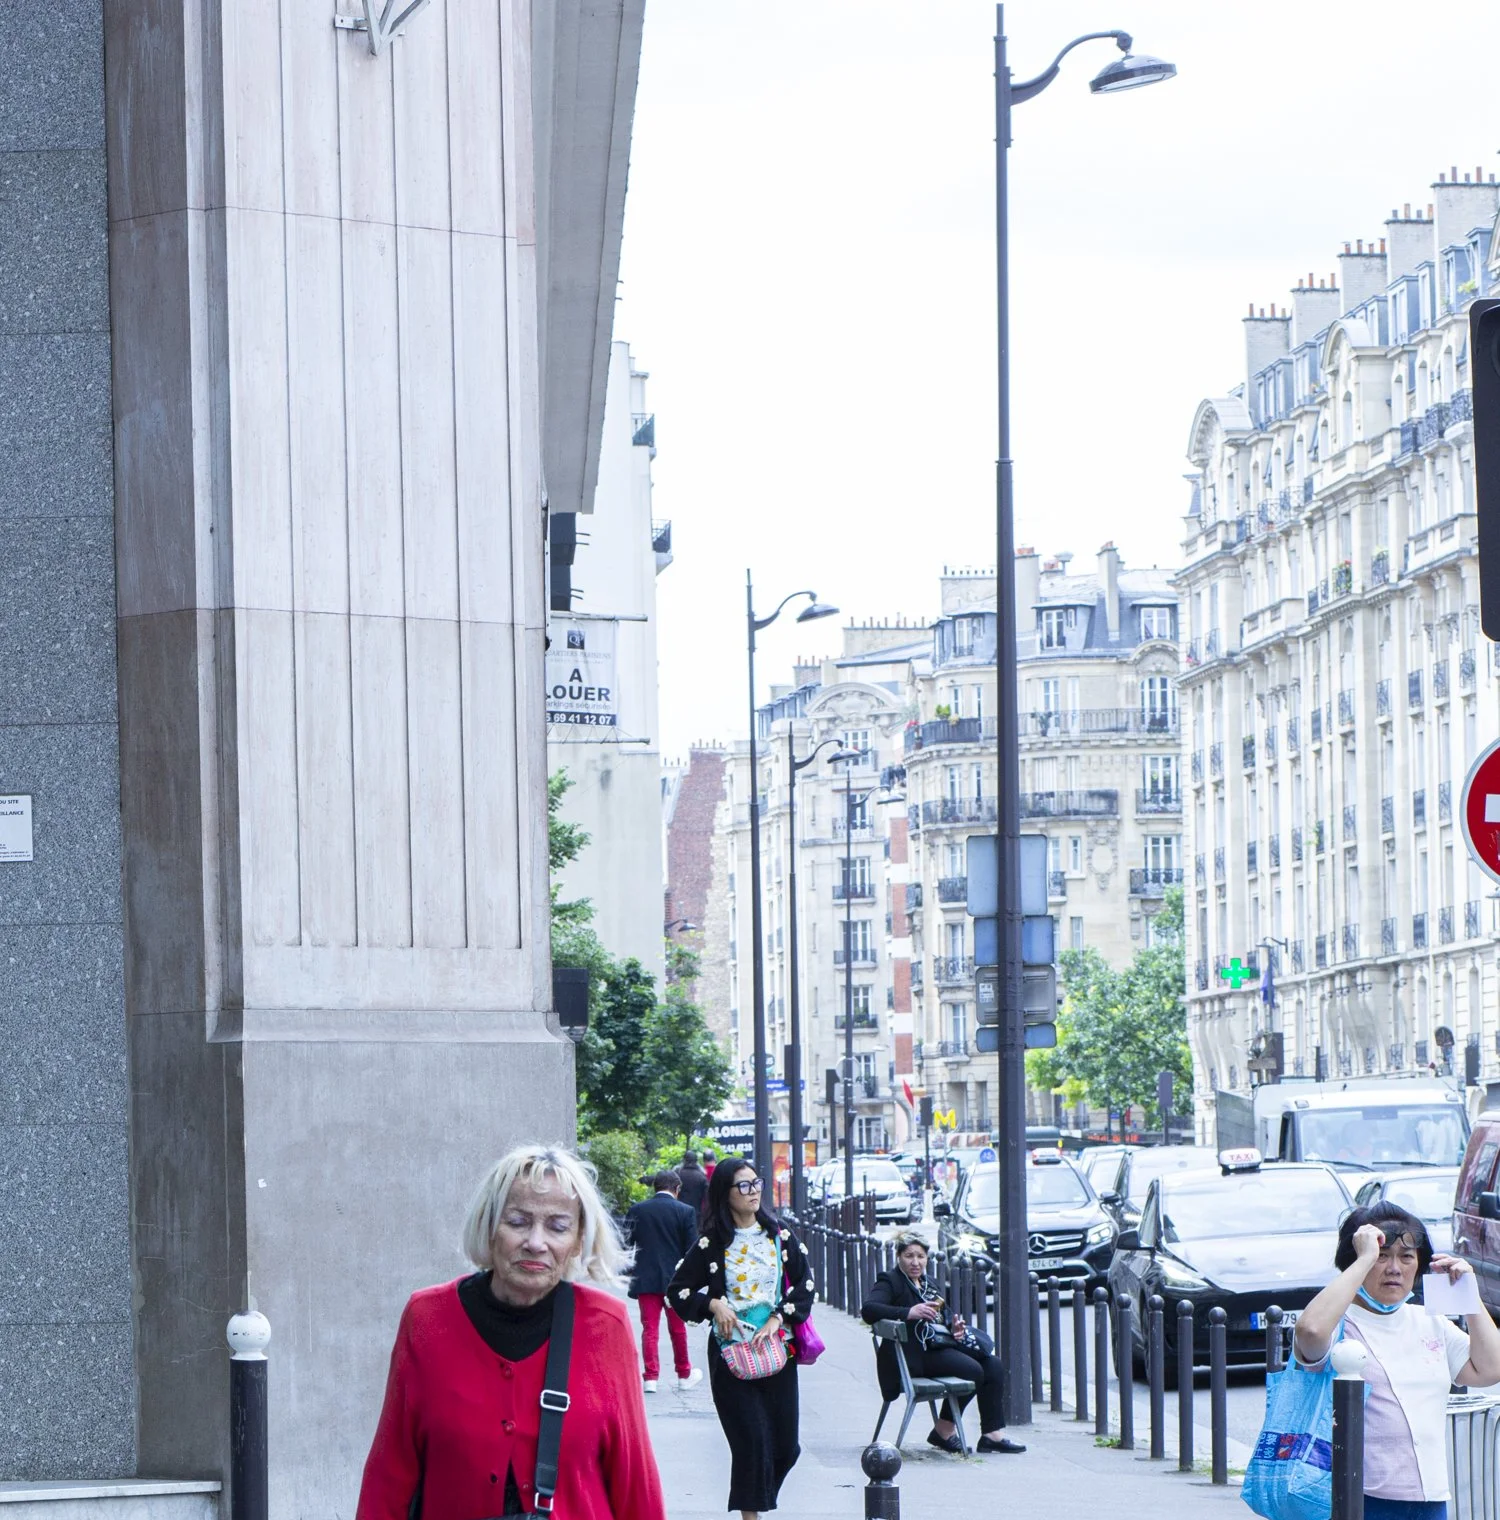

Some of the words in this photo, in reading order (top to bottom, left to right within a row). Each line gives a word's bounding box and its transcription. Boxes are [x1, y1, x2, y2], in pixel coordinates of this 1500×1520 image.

[569, 668, 583, 682] A
[546, 685, 611, 701] OUER
[553, 714, 566, 723] 69
[568, 714, 580, 723] 41
[584, 715, 596, 724] 12
[599, 716, 612, 724] 07
[933, 1109, 956, 1130] M
[1229, 1153, 1254, 1161] TAXI
